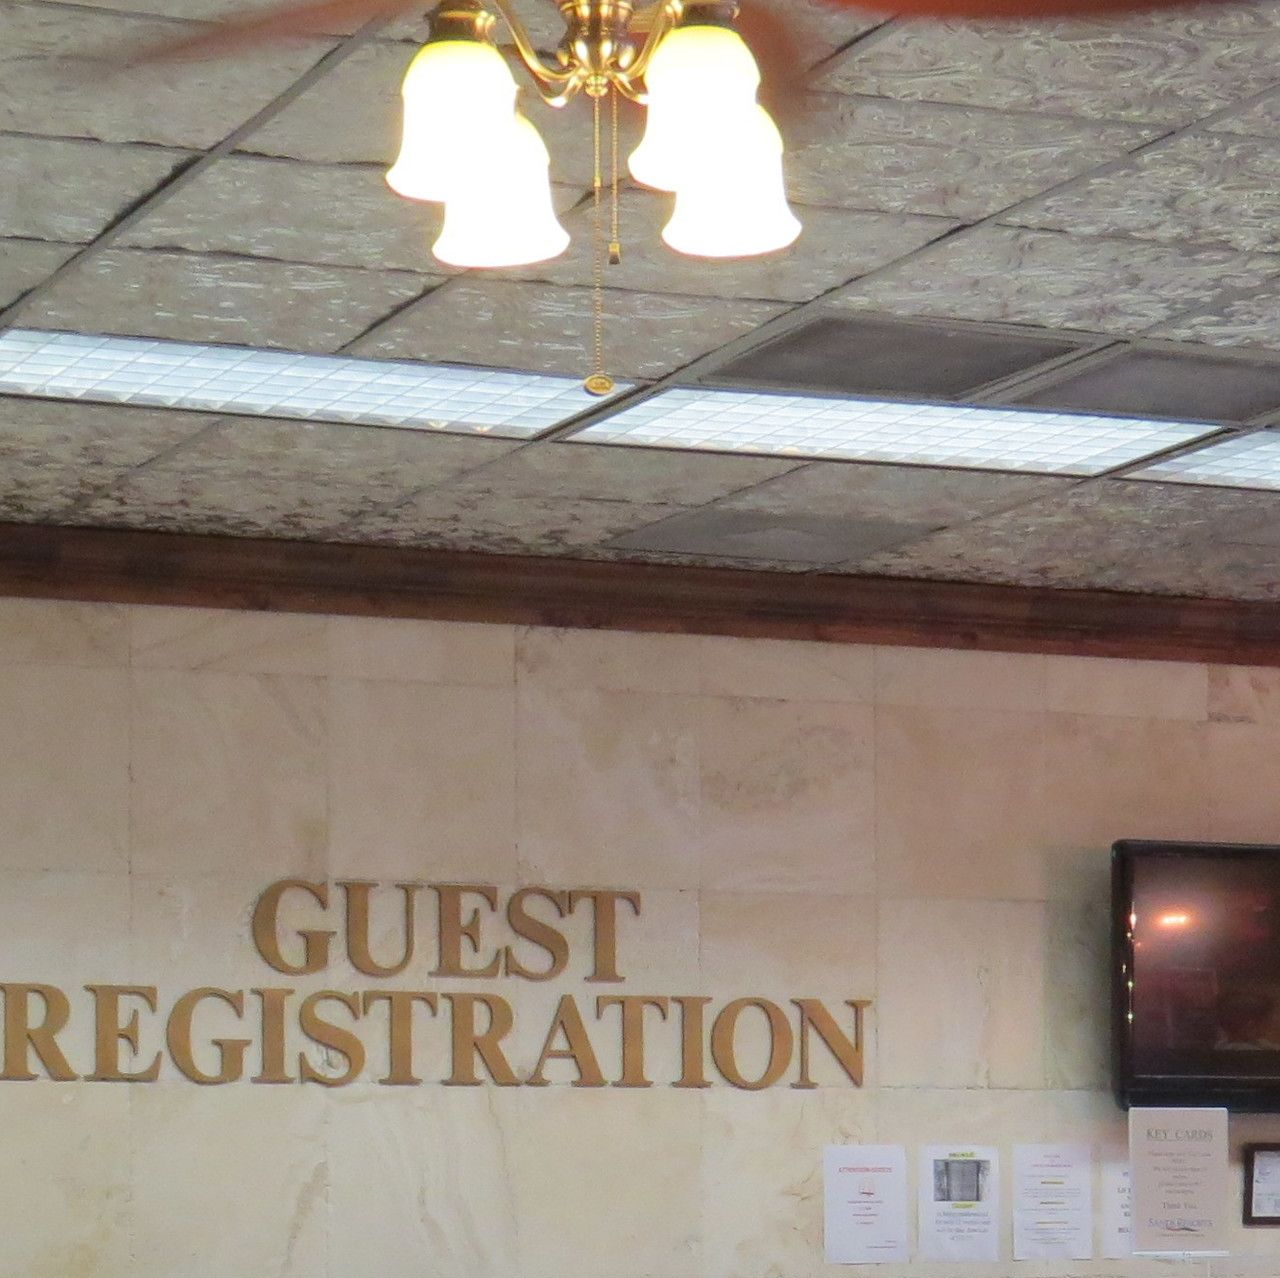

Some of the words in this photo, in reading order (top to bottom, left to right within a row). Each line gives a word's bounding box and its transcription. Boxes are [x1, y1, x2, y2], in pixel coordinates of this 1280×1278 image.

[252, 879, 641, 983] GUEST
[1147, 1129, 1168, 1140] KEY
[1175, 1129, 1213, 1140] CARDS
